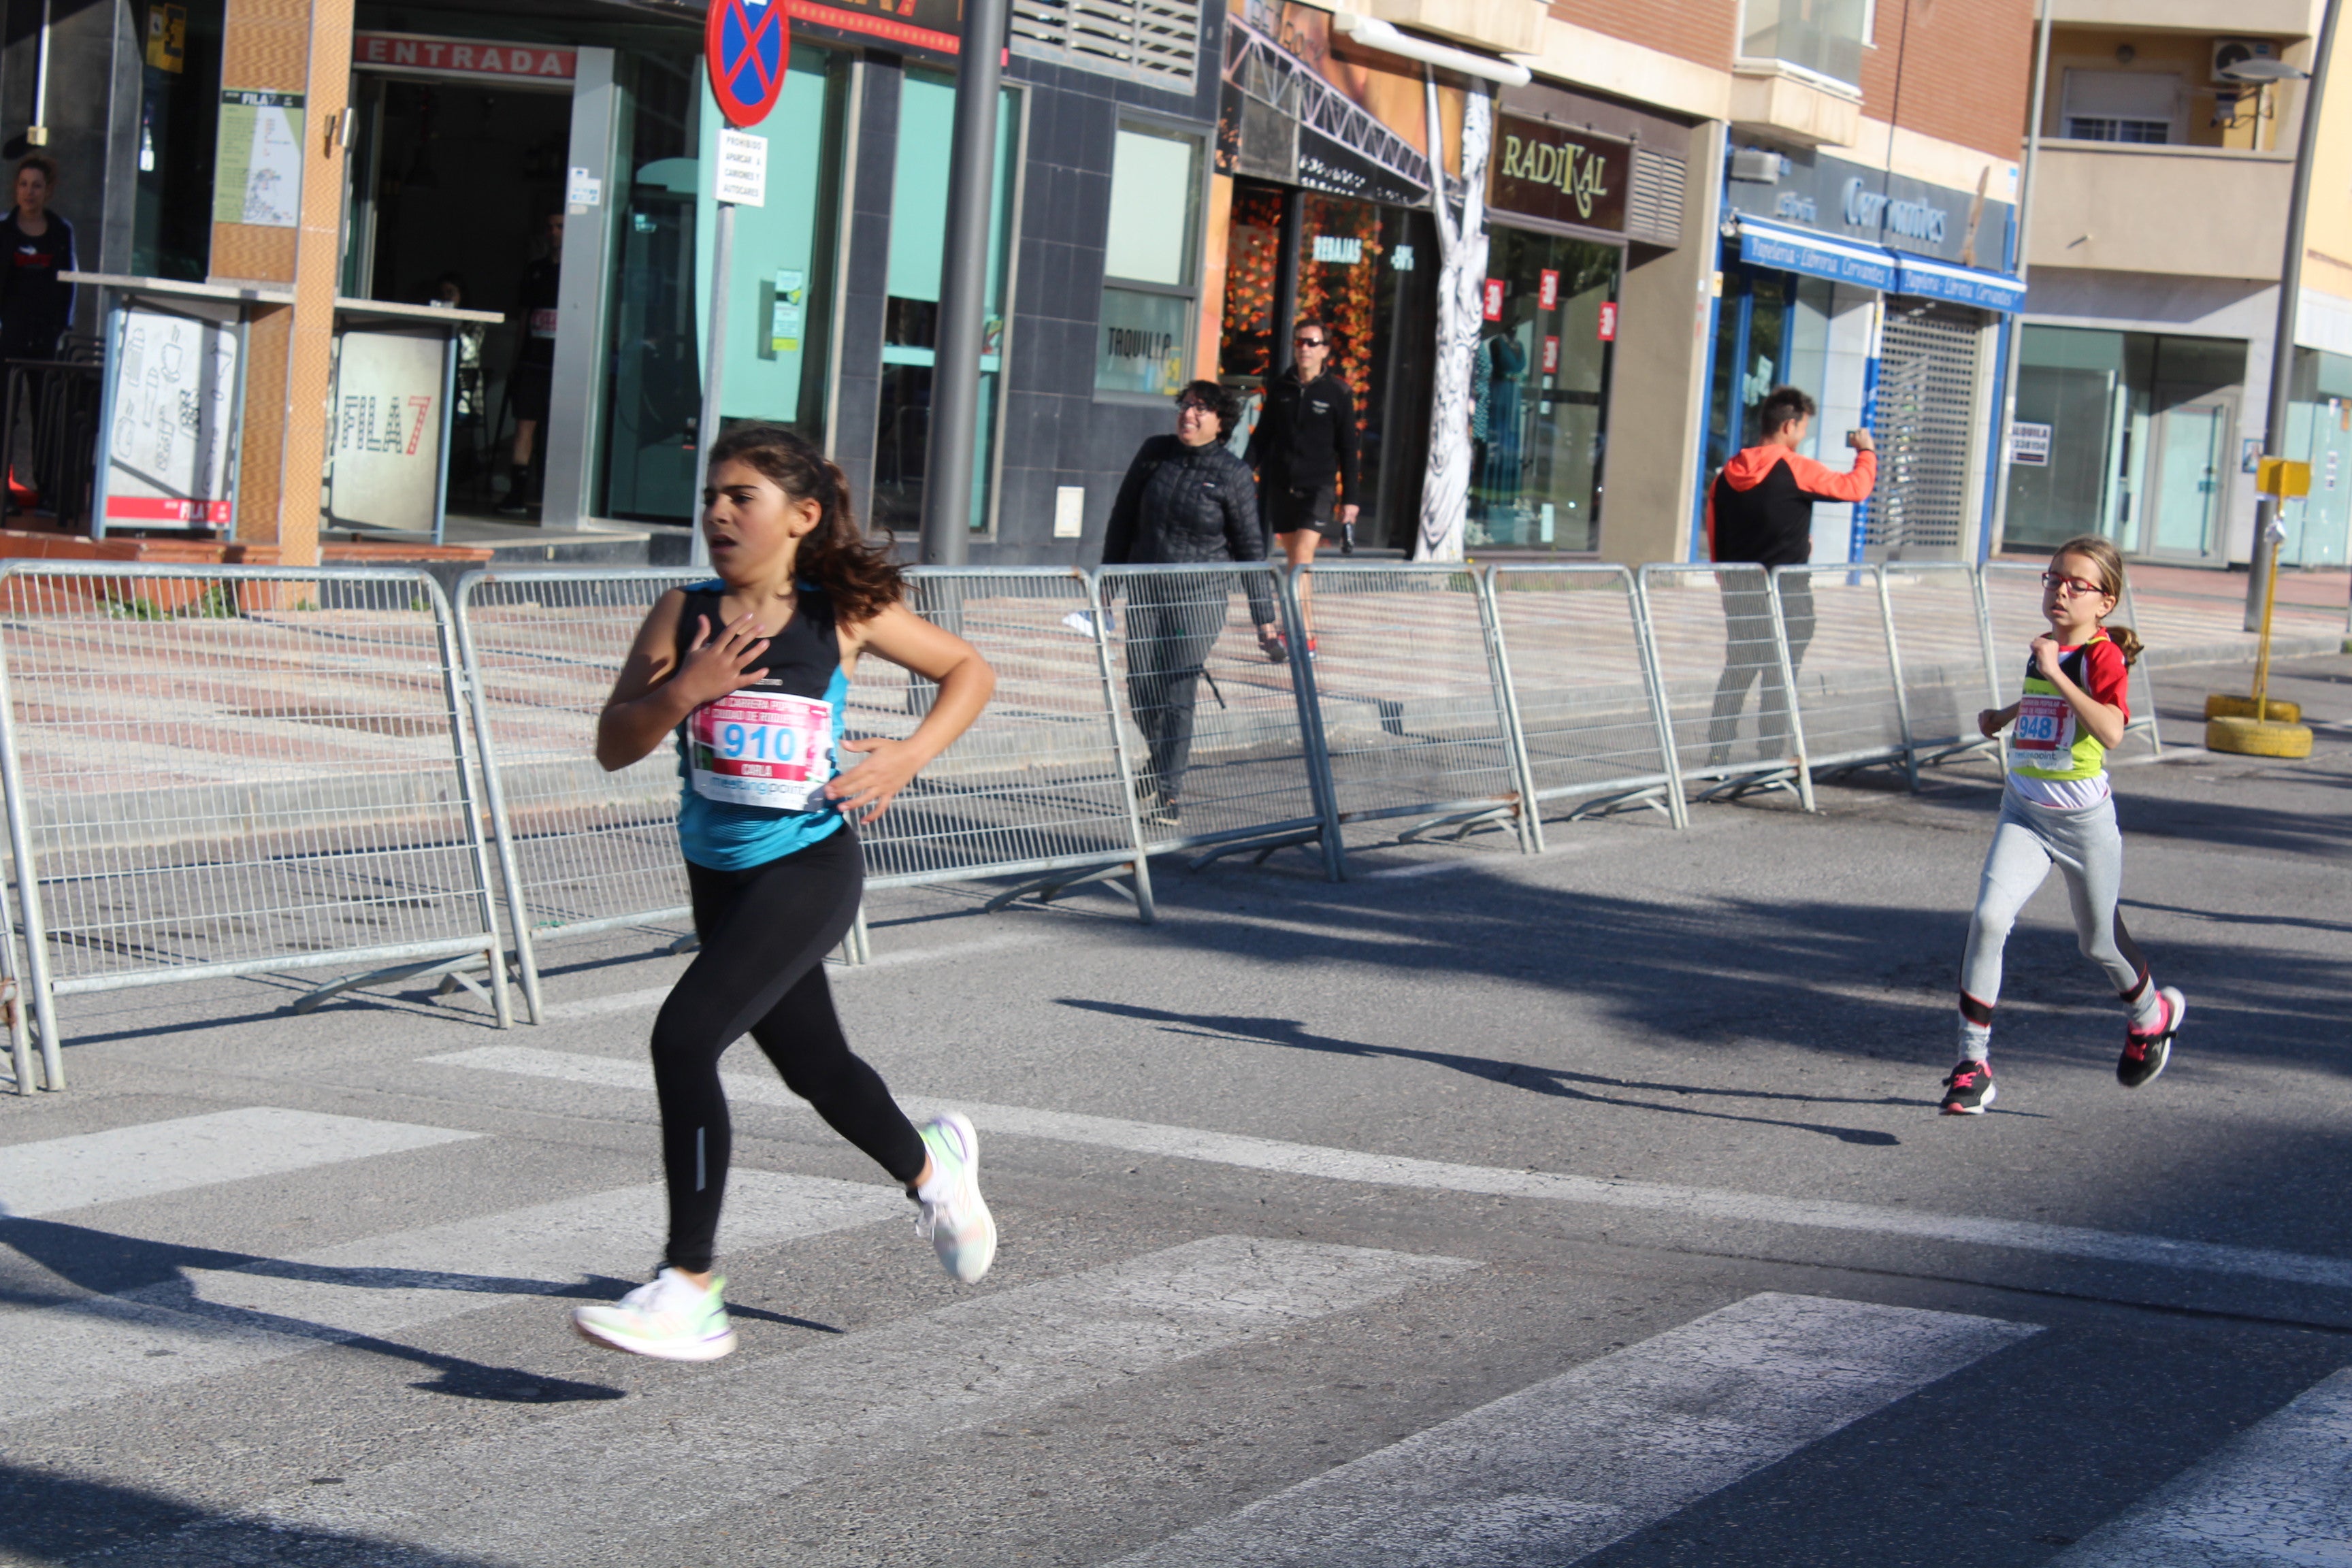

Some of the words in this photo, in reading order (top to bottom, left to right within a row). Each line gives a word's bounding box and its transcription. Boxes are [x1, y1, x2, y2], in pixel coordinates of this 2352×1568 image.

[368, 39, 563, 76] ENTRADA
[726, 136, 762, 150] PROHIBIDO
[725, 152, 752, 164] APARCAR
[756, 157, 761, 165] A
[723, 167, 754, 181] CAMIONES
[1501, 135, 1608, 219] RADIKAL
[723, 183, 759, 197] AUTOCARES
[1840, 176, 1948, 244] Cervantes
[1313, 235, 1362, 265] REBAJAS
[1842, 257, 1885, 285] Cervantes
[342, 393, 432, 455] FILA7
[729, 697, 770, 710] CARRERA
[711, 708, 745, 721] CIUDAD
[746, 712, 759, 721] DE
[2019, 716, 2052, 739] 948
[723, 723, 796, 762] 910
[740, 763, 773, 777] CARLA
[710, 776, 808, 796] meetingpoint
